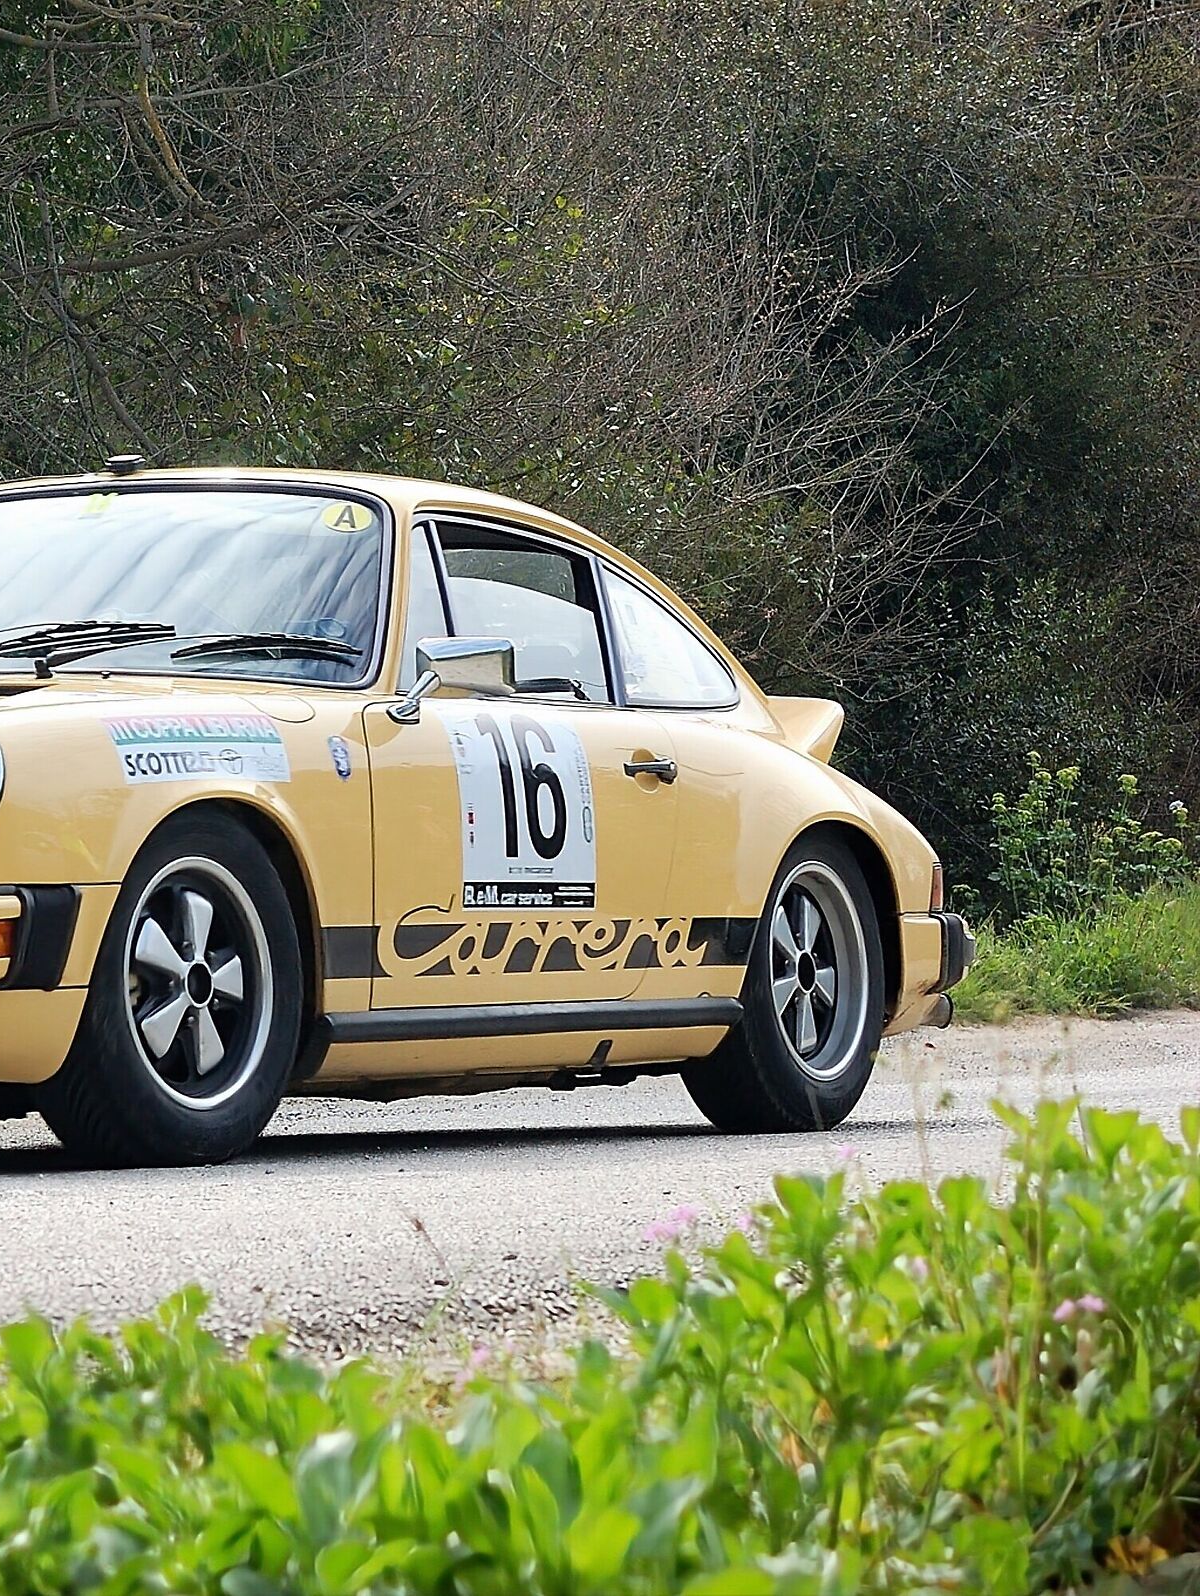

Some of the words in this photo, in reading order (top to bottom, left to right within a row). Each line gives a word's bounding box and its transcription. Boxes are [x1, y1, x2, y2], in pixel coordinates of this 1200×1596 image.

[333, 504, 356, 528] A
[474, 713, 567, 860] 16
[377, 893, 708, 977] Carrera
